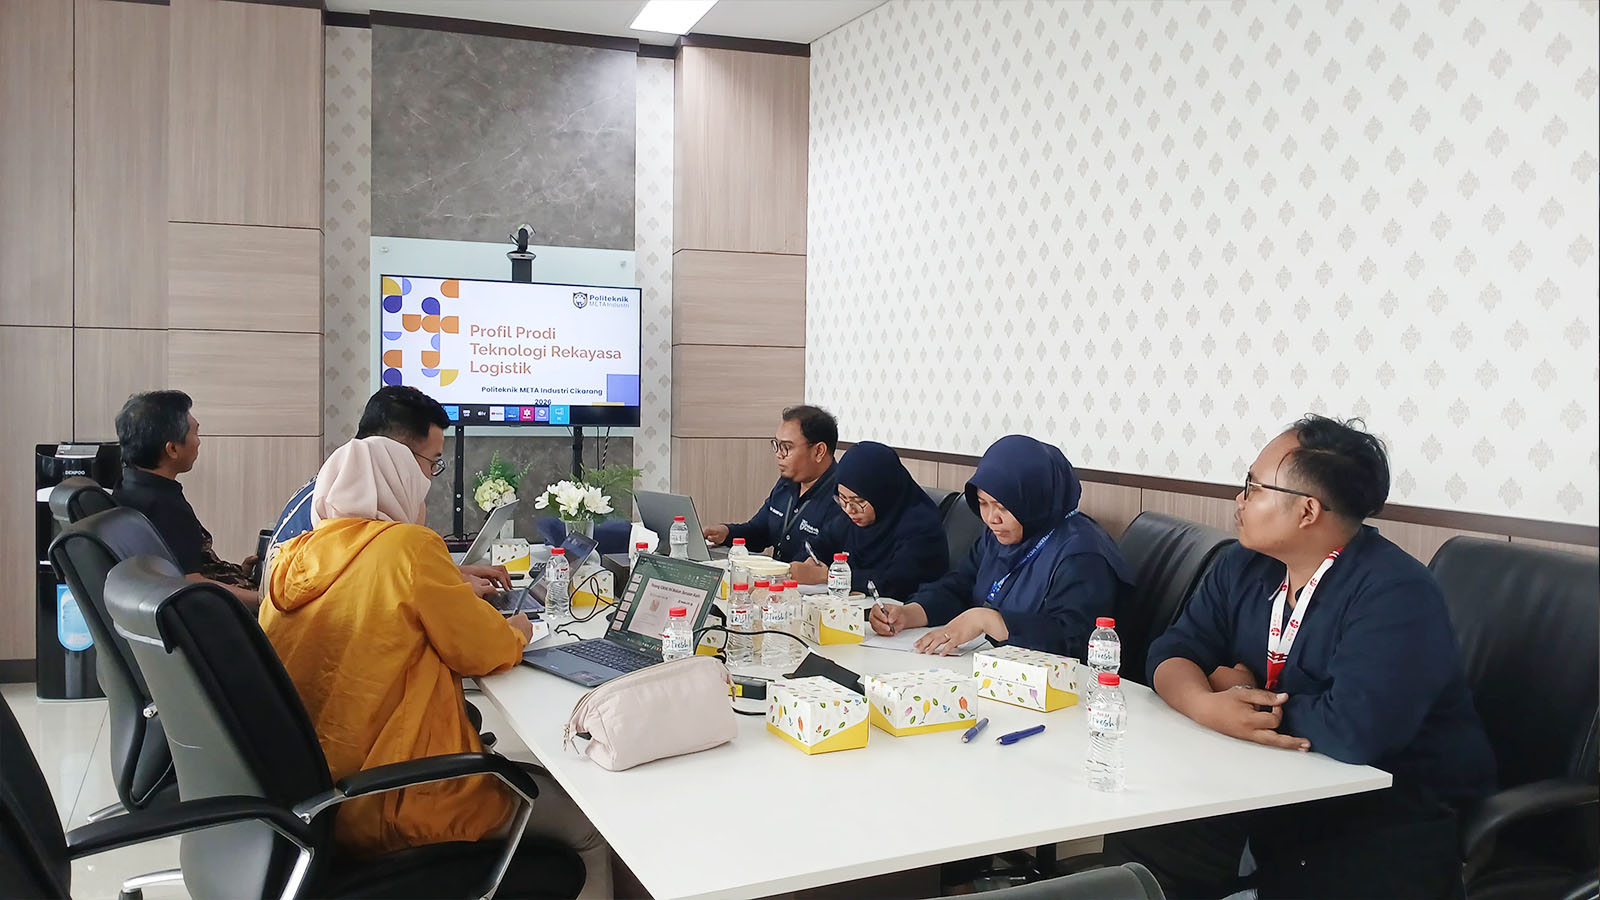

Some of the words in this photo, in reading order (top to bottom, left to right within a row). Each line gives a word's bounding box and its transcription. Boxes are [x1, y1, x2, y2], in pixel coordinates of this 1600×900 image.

[589, 295, 629, 303] Politeknik
[470, 324, 512, 339] Profil
[516, 326, 556, 340] Prodi
[470, 343, 547, 360] Teknologi
[551, 346, 622, 362] Rekayasa
[470, 361, 532, 377] Logistik
[481, 386, 518, 394] Politeknik
[540, 387, 569, 395] Industri
[570, 388, 603, 397] Cikarang
